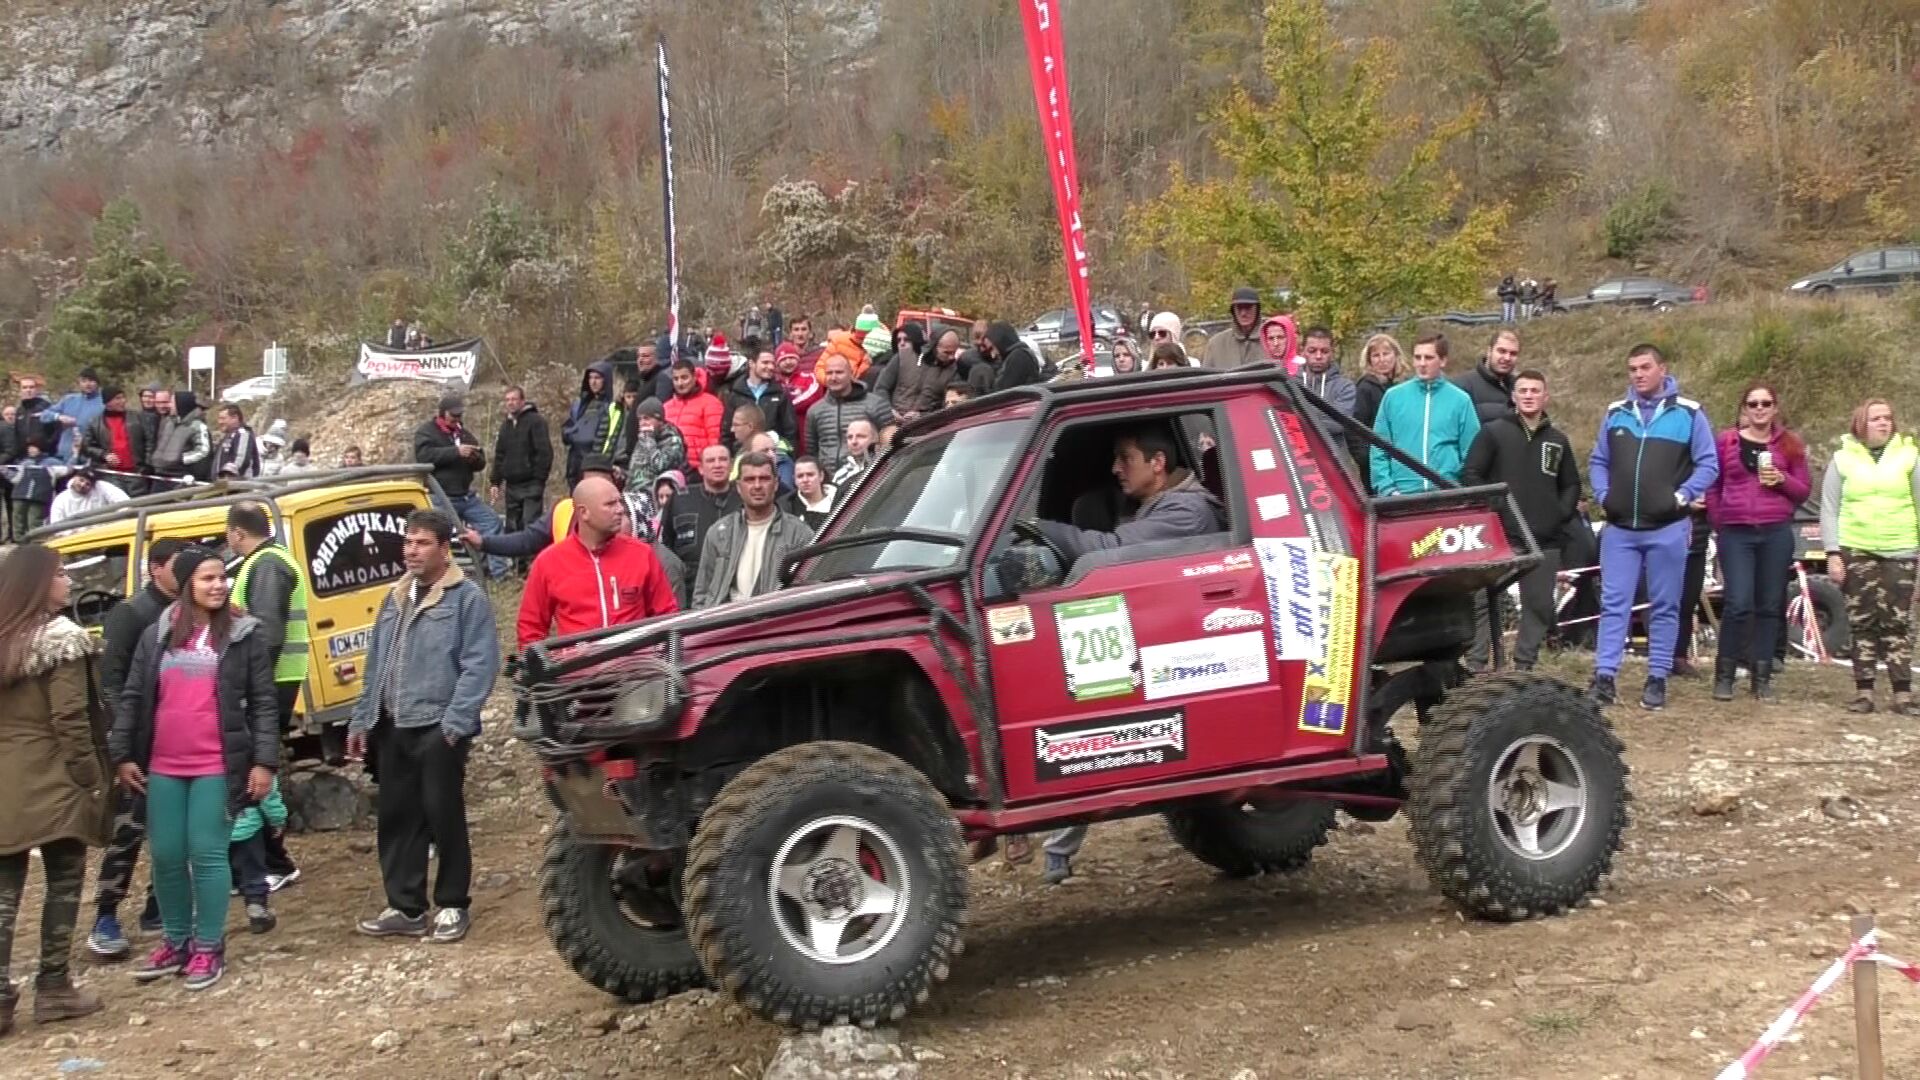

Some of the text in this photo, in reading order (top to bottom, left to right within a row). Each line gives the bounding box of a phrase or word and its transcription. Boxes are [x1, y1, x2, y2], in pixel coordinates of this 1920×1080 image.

[366, 356, 468, 374] POWERWINCH
[311, 512, 408, 576] ФИРМИЧКАТ
[1282, 541, 1314, 638] off road
[1071, 626, 1124, 666] 208
[1173, 661, 1228, 681] ПРИНТА
[1047, 723, 1174, 759] POWERWINCH
[1059, 749, 1164, 775] www.lebedka.bg
